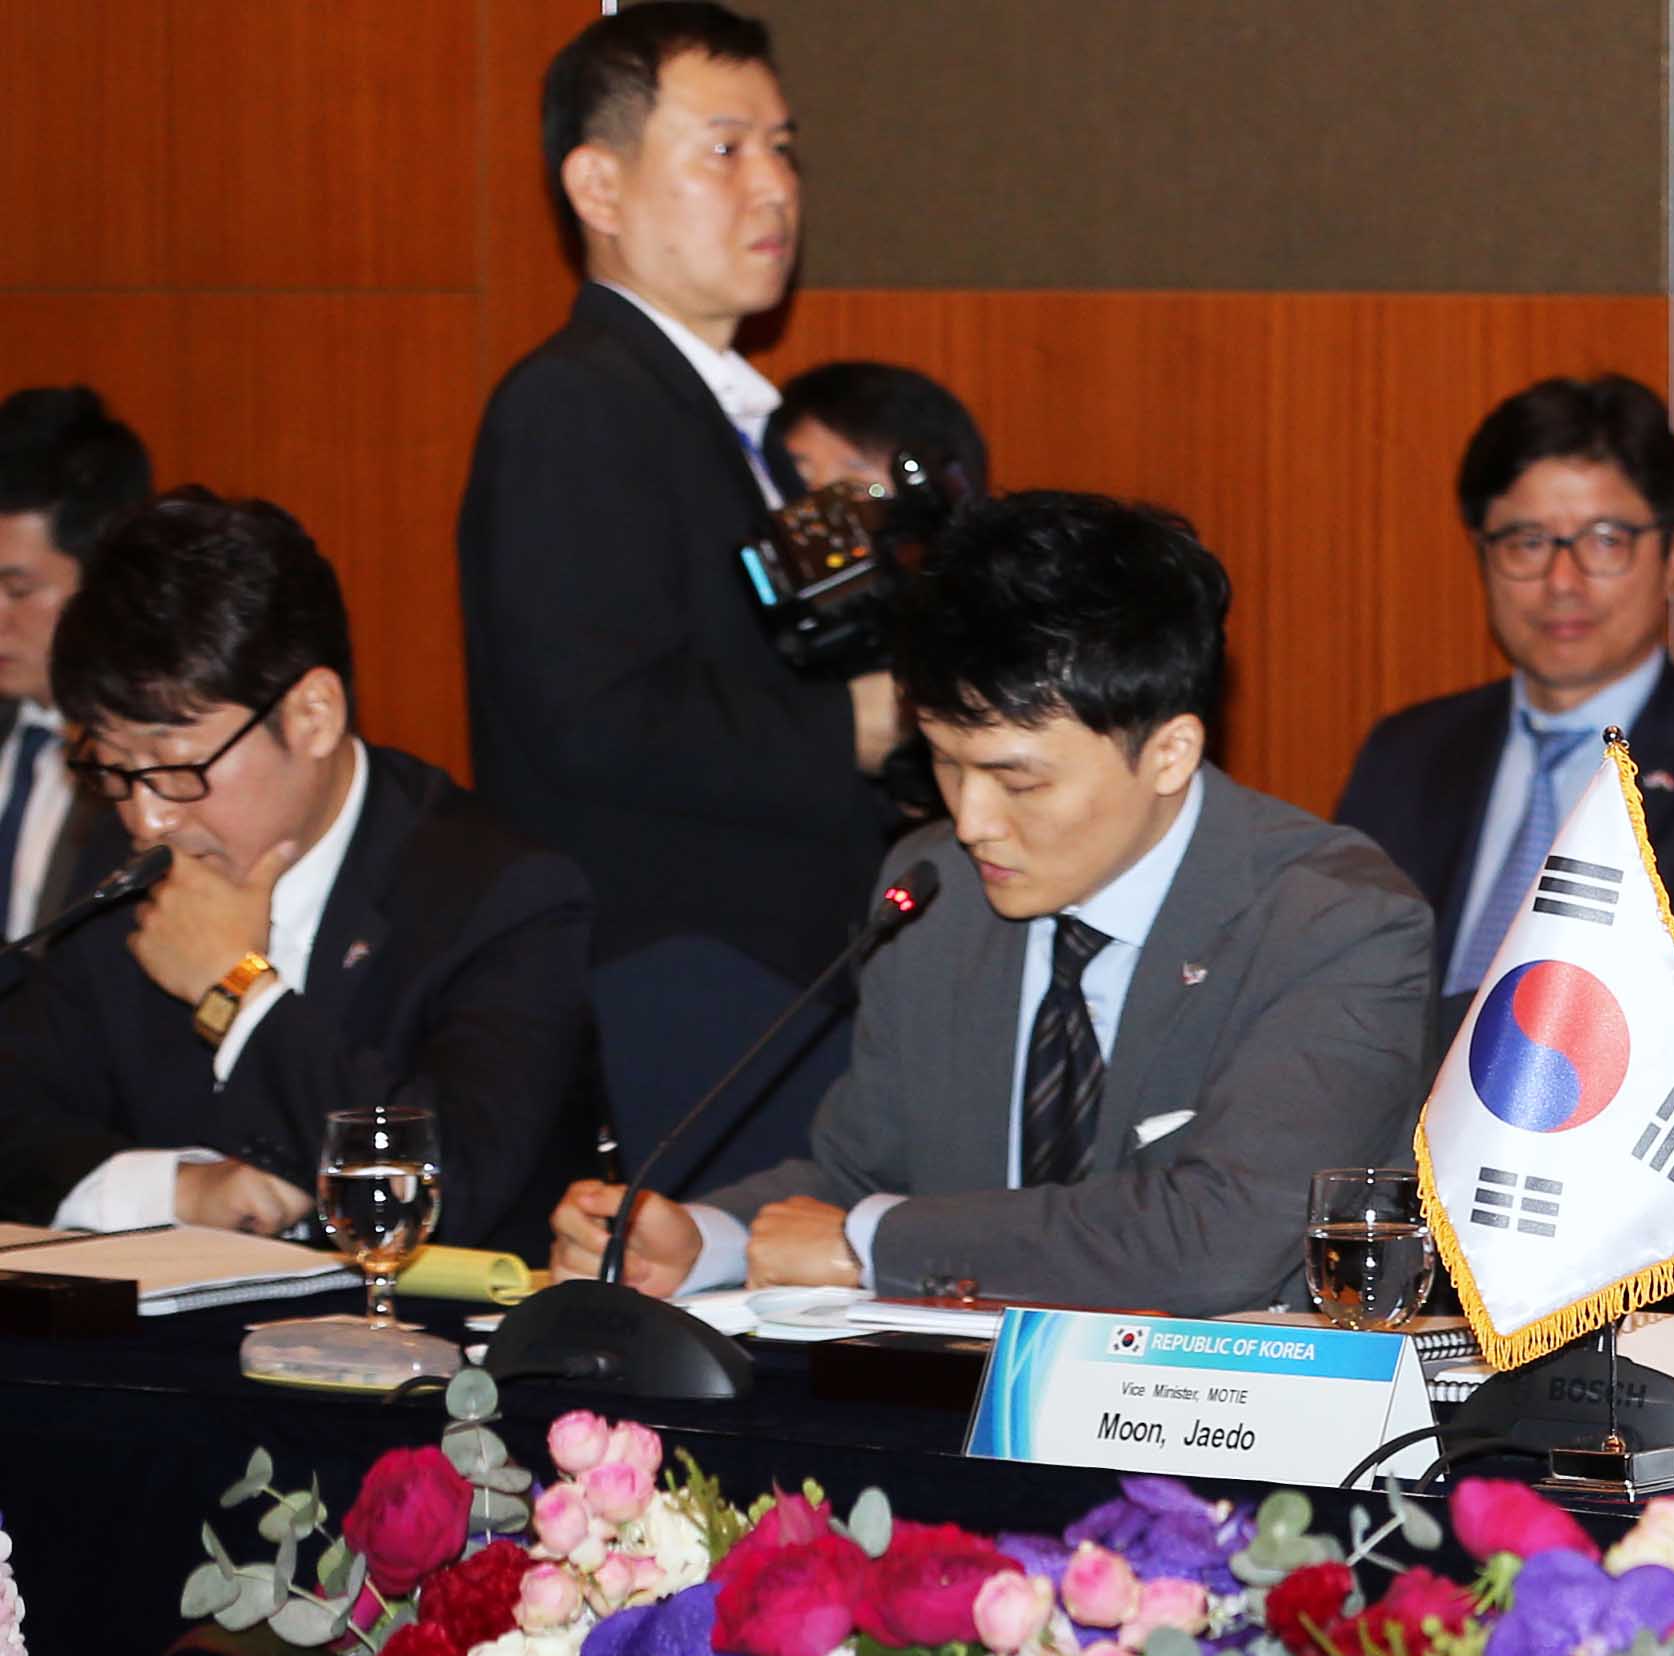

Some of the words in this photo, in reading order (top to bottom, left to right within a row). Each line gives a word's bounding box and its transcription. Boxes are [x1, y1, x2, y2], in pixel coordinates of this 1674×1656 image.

[1152, 1333, 1231, 1355] REPUBLIC
[1232, 1339, 1257, 1358] OF
[1258, 1340, 1315, 1361] KOREA
[1121, 1381, 1146, 1398] Vice
[1207, 1387, 1249, 1405] MOTIE
[1097, 1412, 1166, 1448] Moon,
[1184, 1419, 1256, 1451] Jaedo
